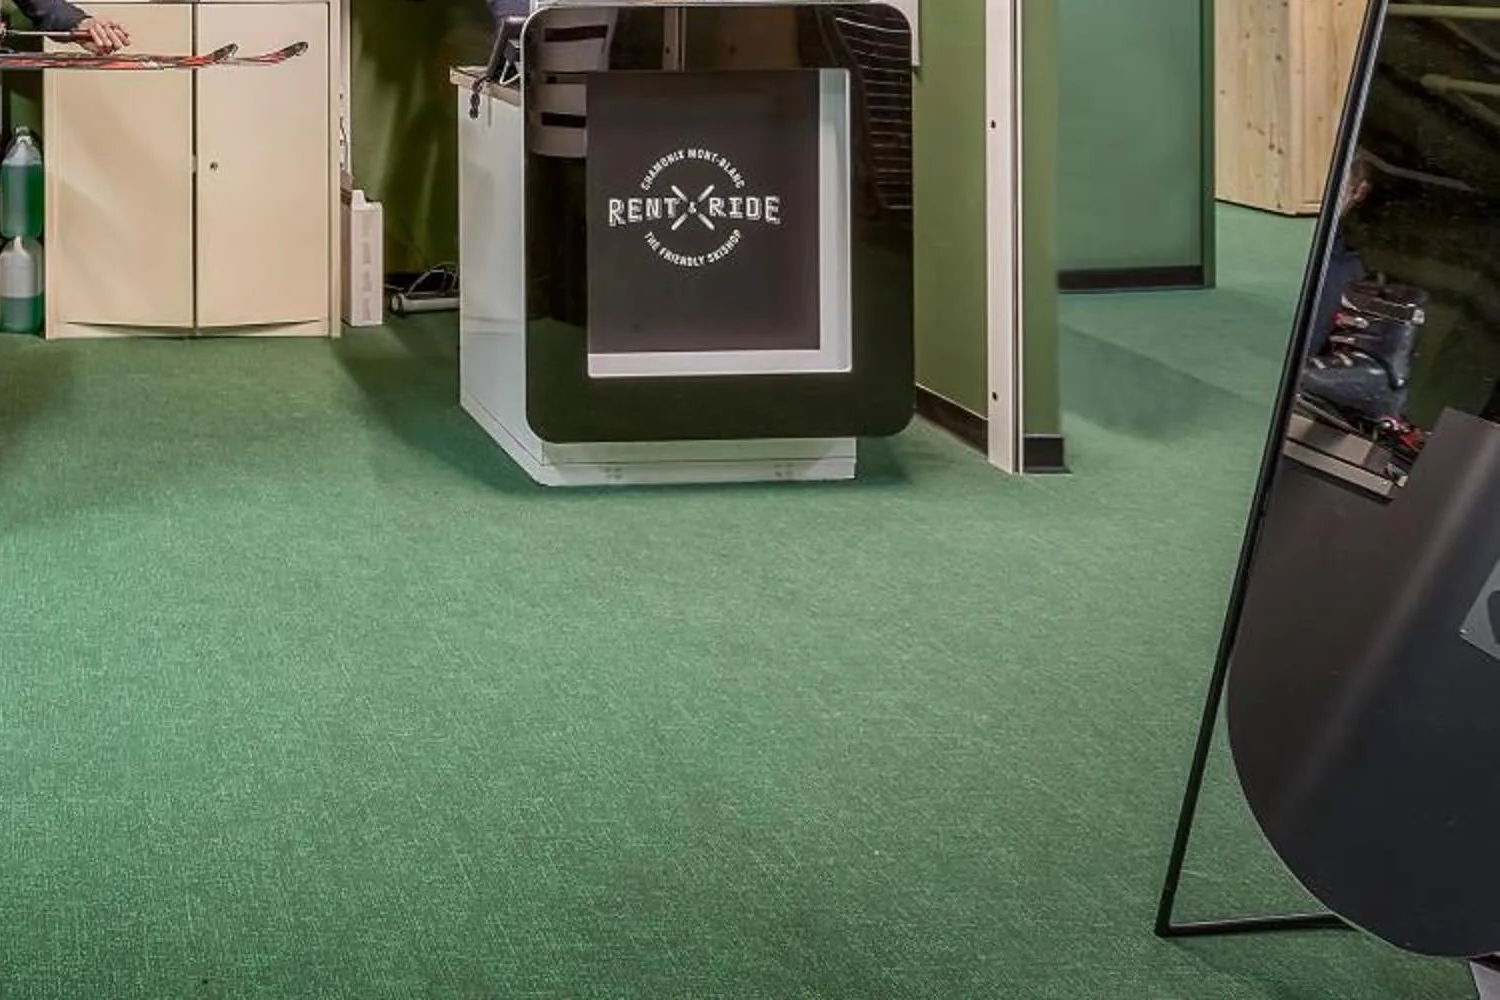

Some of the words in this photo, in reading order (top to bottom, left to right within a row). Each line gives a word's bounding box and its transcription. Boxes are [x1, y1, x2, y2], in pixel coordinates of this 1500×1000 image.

[640, 150, 685, 192] CHAMONIX
[687, 148, 746, 189] MONT-BLANC
[608, 196, 681, 228] RENT
[708, 195, 782, 226] RIDE
[644, 230, 661, 251] THE
[658, 247, 706, 268] FRIENDLY
[707, 228, 742, 264] SKISHOP
